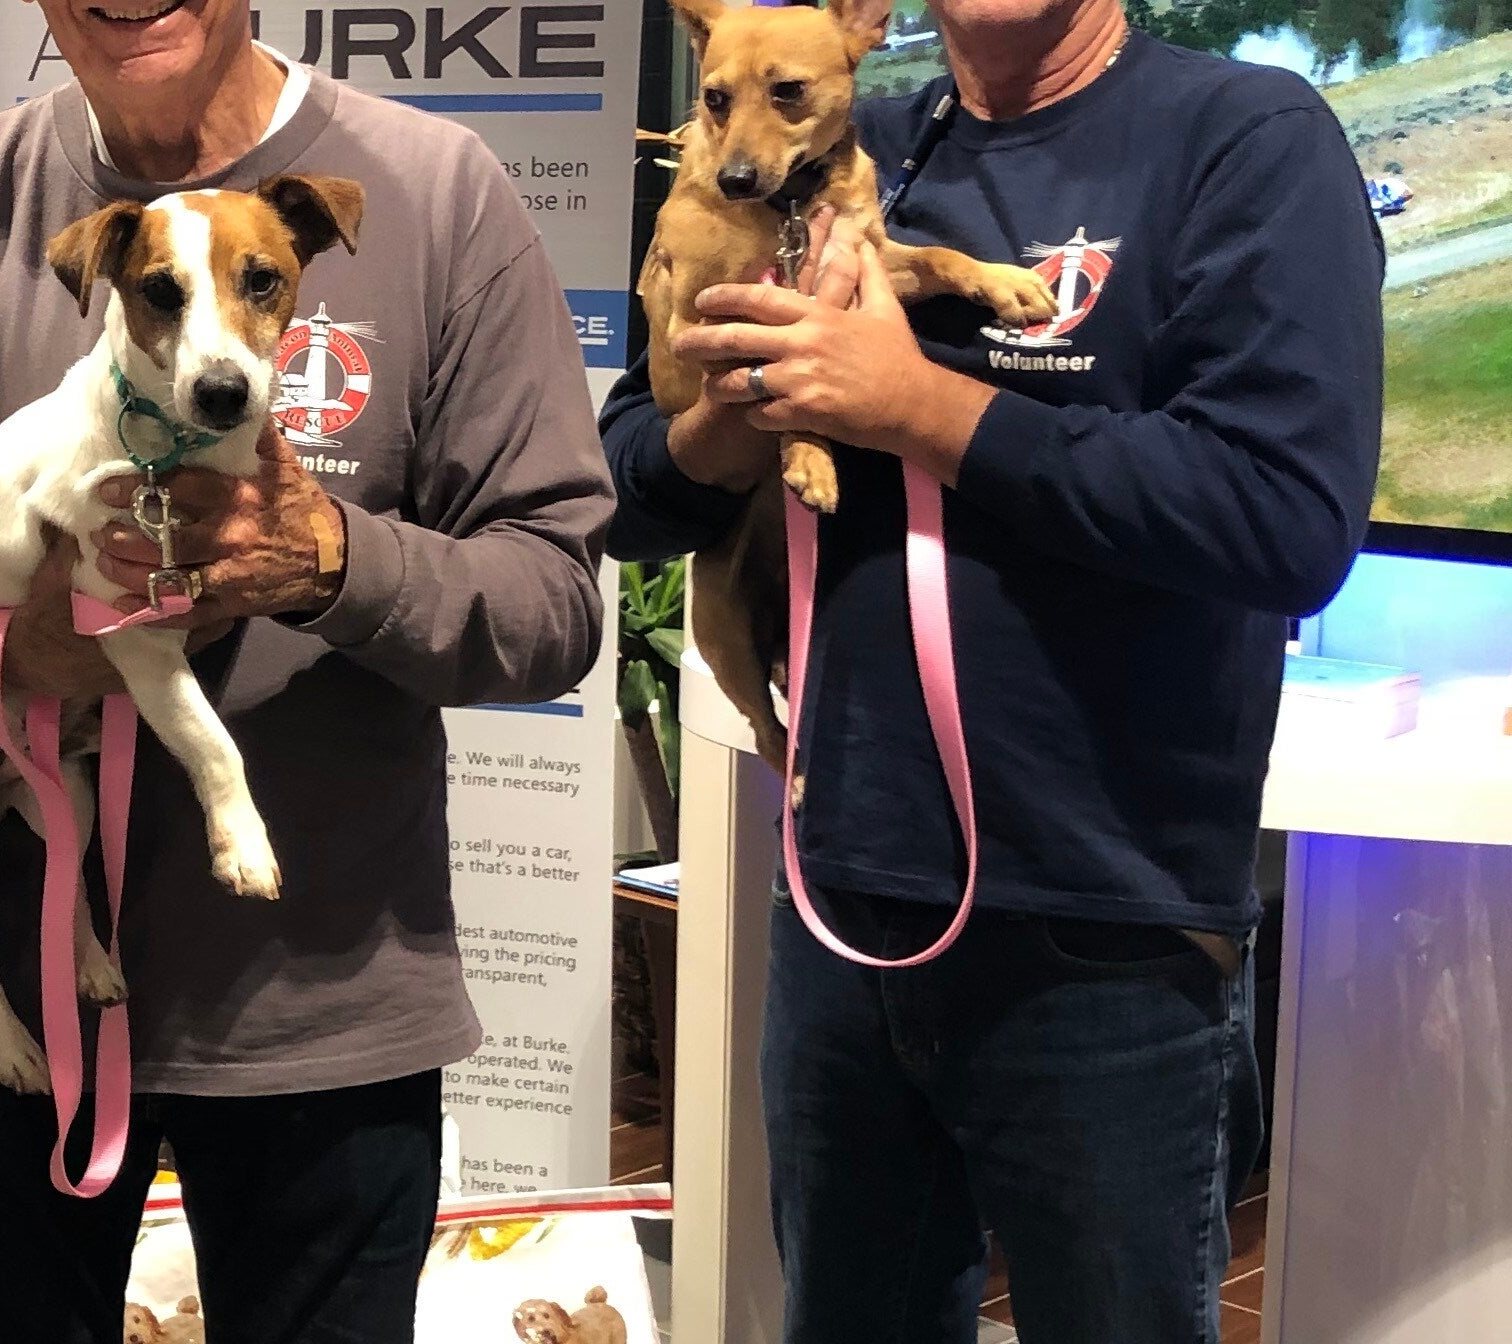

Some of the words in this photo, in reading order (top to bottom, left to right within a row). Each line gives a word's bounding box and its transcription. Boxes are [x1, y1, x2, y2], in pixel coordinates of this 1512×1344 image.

[250, 6, 605, 80] URKE
[531, 155, 588, 178] been
[566, 189, 587, 211] in
[576, 315, 615, 335] CE.
[989, 351, 1096, 372] Volunteer
[296, 454, 360, 474] nteer
[466, 751, 492, 766] We
[498, 753, 524, 769] will
[529, 756, 581, 775] always
[461, 772, 497, 787] time
[502, 776, 579, 798] necessary
[465, 839, 491, 853] sell
[496, 842, 526, 857] you
[531, 846, 541, 857] a
[546, 848, 571, 862] car,
[469, 858, 512, 875] that's
[518, 866, 526, 876] a
[532, 864, 579, 883] better
[489, 928, 578, 949] automotive
[495, 947, 519, 963] the
[524, 951, 577, 972] pricing
[502, 1036, 518, 1048] at
[523, 1035, 570, 1054] Burke.
[547, 1058, 573, 1074] We
[445, 1071, 461, 1084] to
[466, 1072, 509, 1088] make
[515, 1078, 569, 1094] certain
[443, 1092, 481, 1106] etter
[485, 1094, 573, 1116] experience
[461, 1156, 488, 1171] has
[493, 1158, 533, 1176] been
[539, 1166, 548, 1178] a
